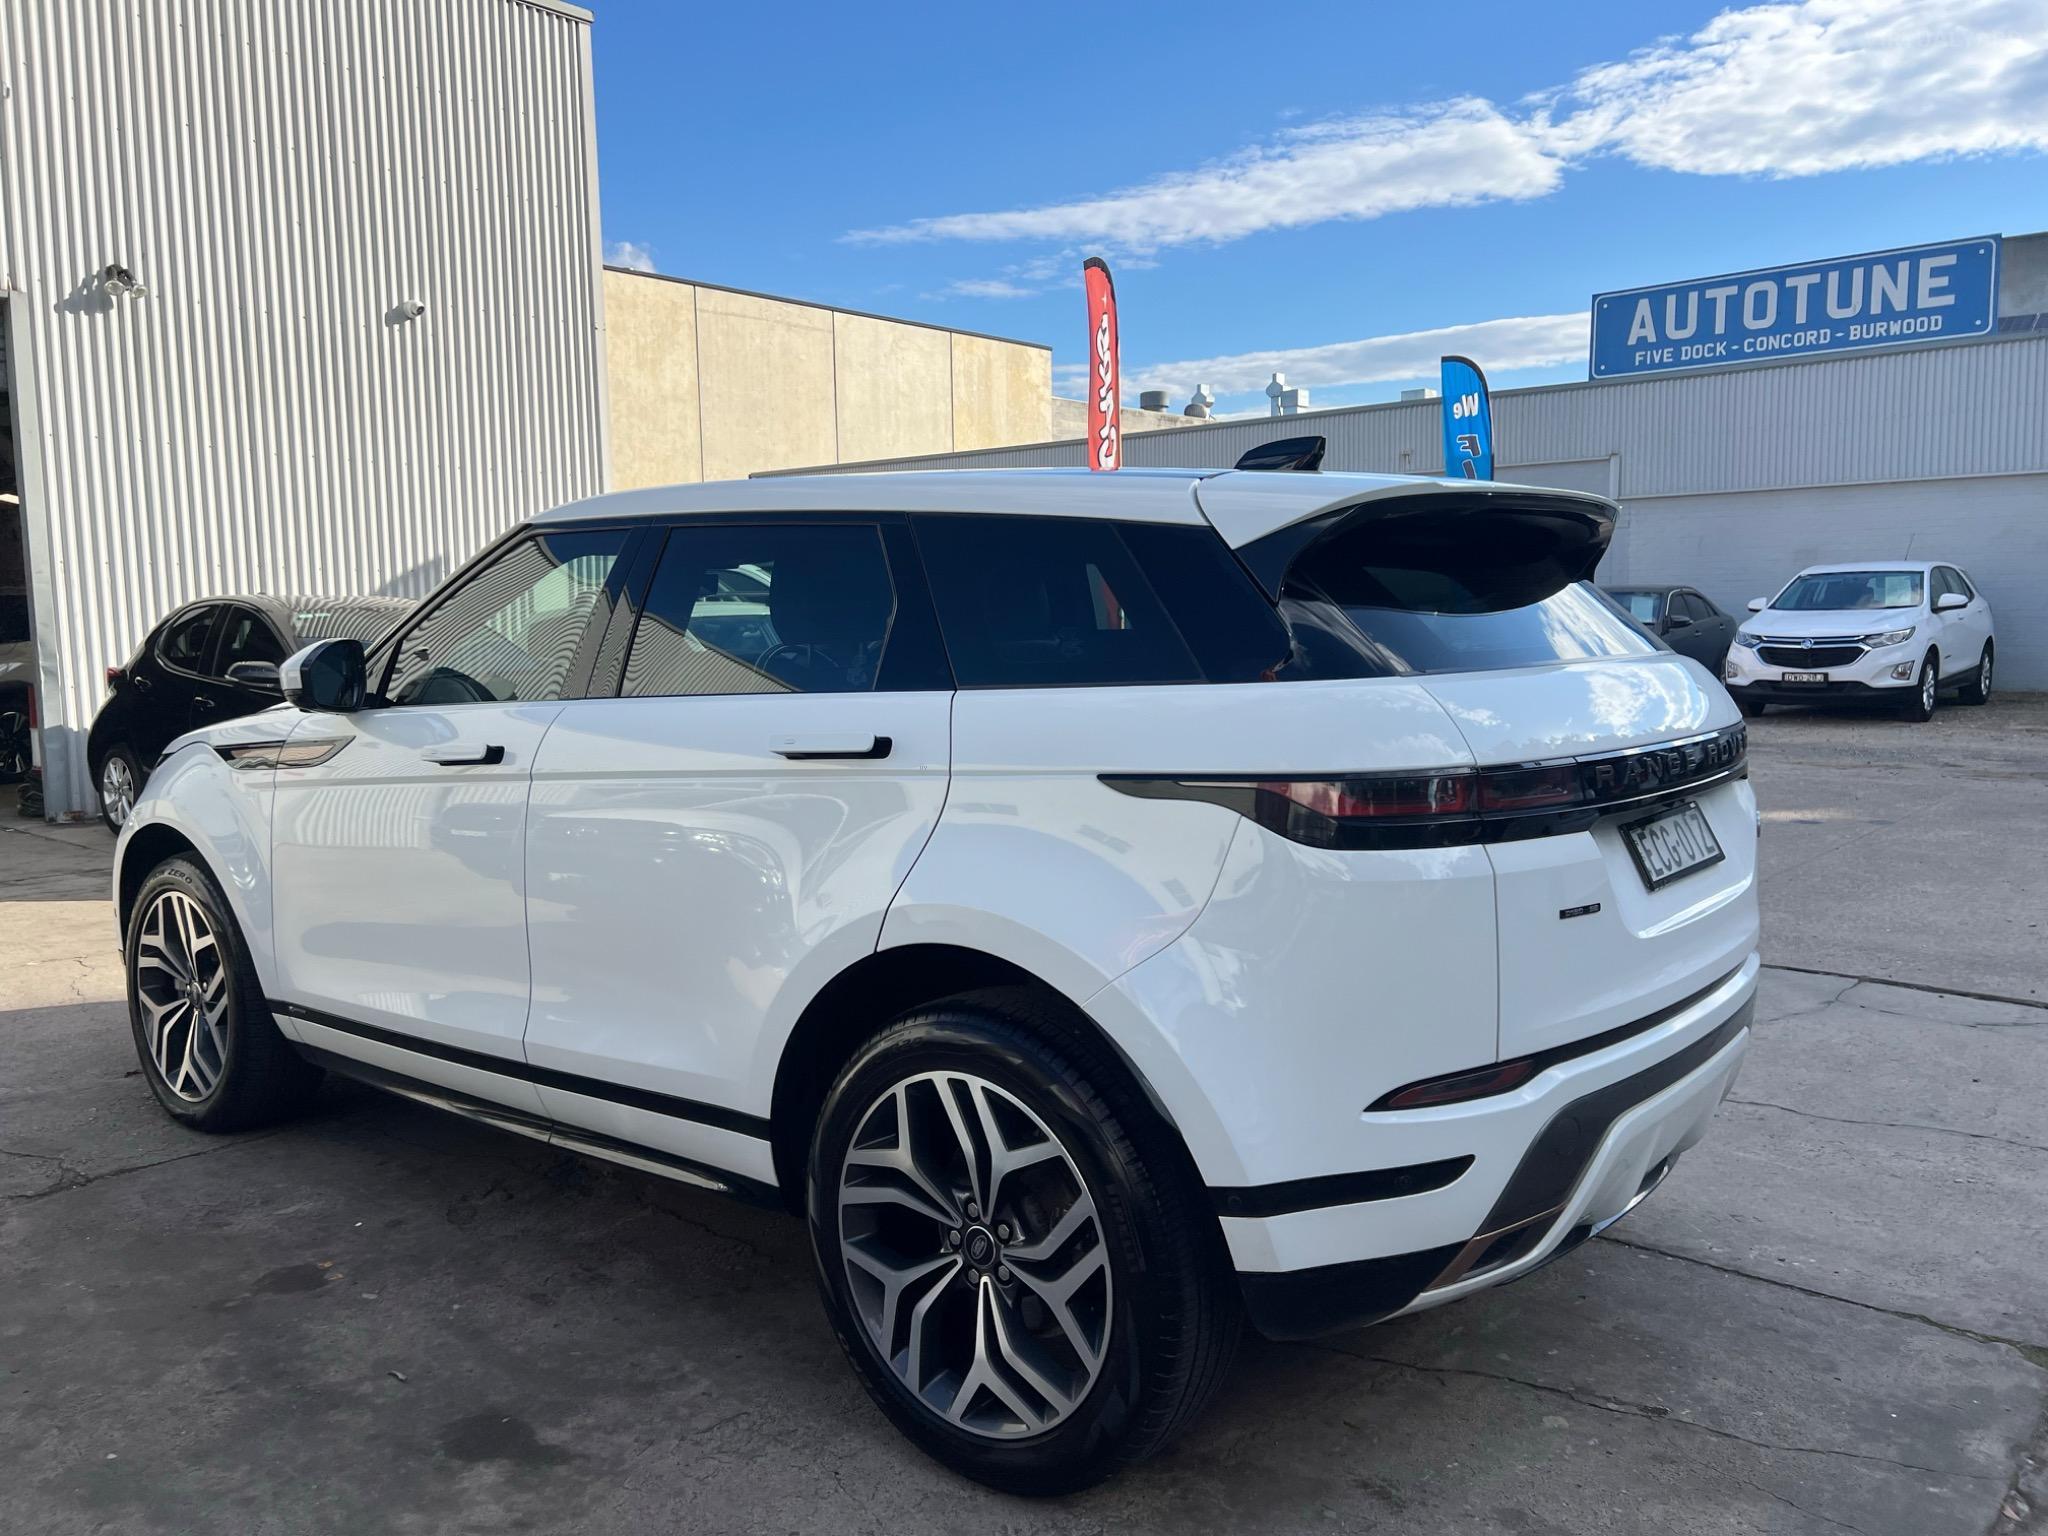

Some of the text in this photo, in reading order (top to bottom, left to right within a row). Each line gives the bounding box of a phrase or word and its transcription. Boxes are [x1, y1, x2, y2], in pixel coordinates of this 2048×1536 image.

[1627, 254, 1958, 346] AUTOTUNE
[1635, 348, 1673, 366] FIVE
[1681, 341, 1727, 361] DOCK
[1743, 328, 1830, 353] CONCORD
[1849, 315, 1942, 341] BURWOOD
[1595, 749, 1698, 788] RANGE
